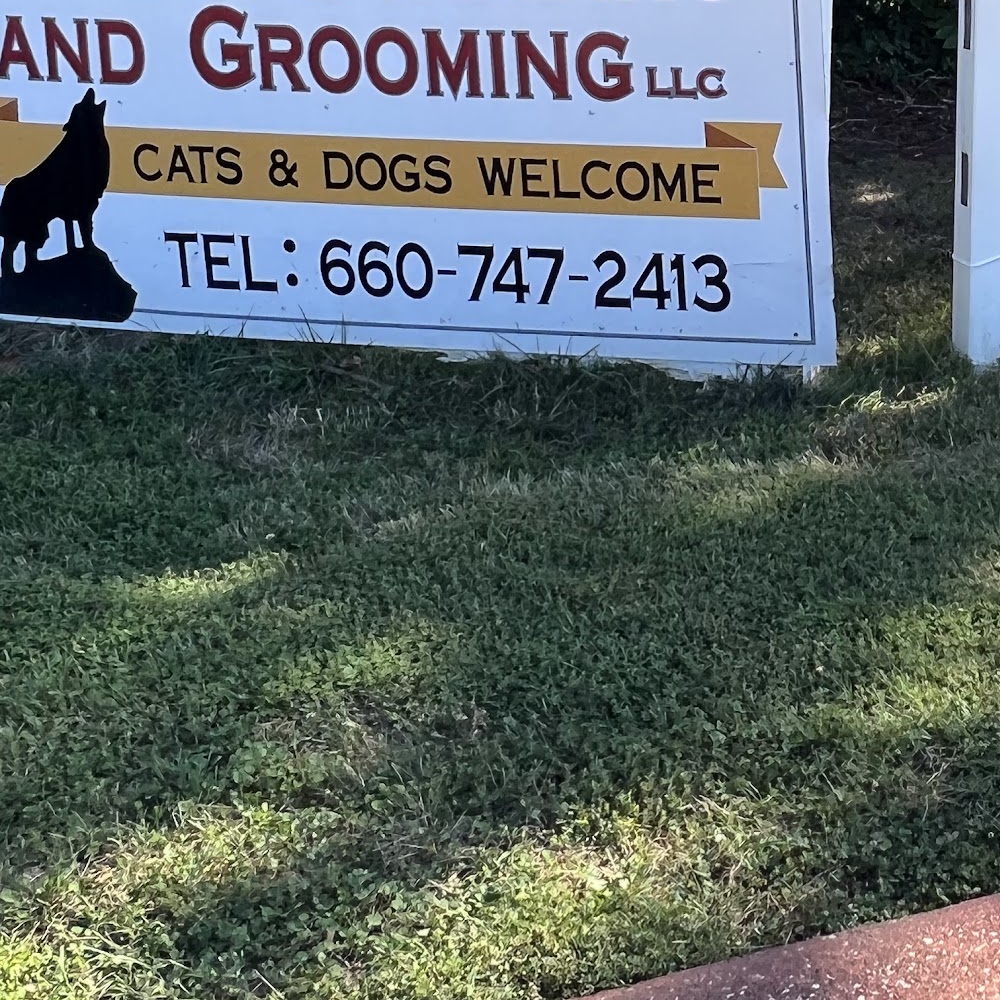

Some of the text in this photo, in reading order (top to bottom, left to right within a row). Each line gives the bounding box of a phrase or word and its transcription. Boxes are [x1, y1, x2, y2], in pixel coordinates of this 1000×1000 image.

[0, 4, 729, 102] AND GROOMING LLC
[133, 143, 723, 204] CATS & DOGS WELCOME
[164, 230, 732, 313] TEL: 660-747-2413
